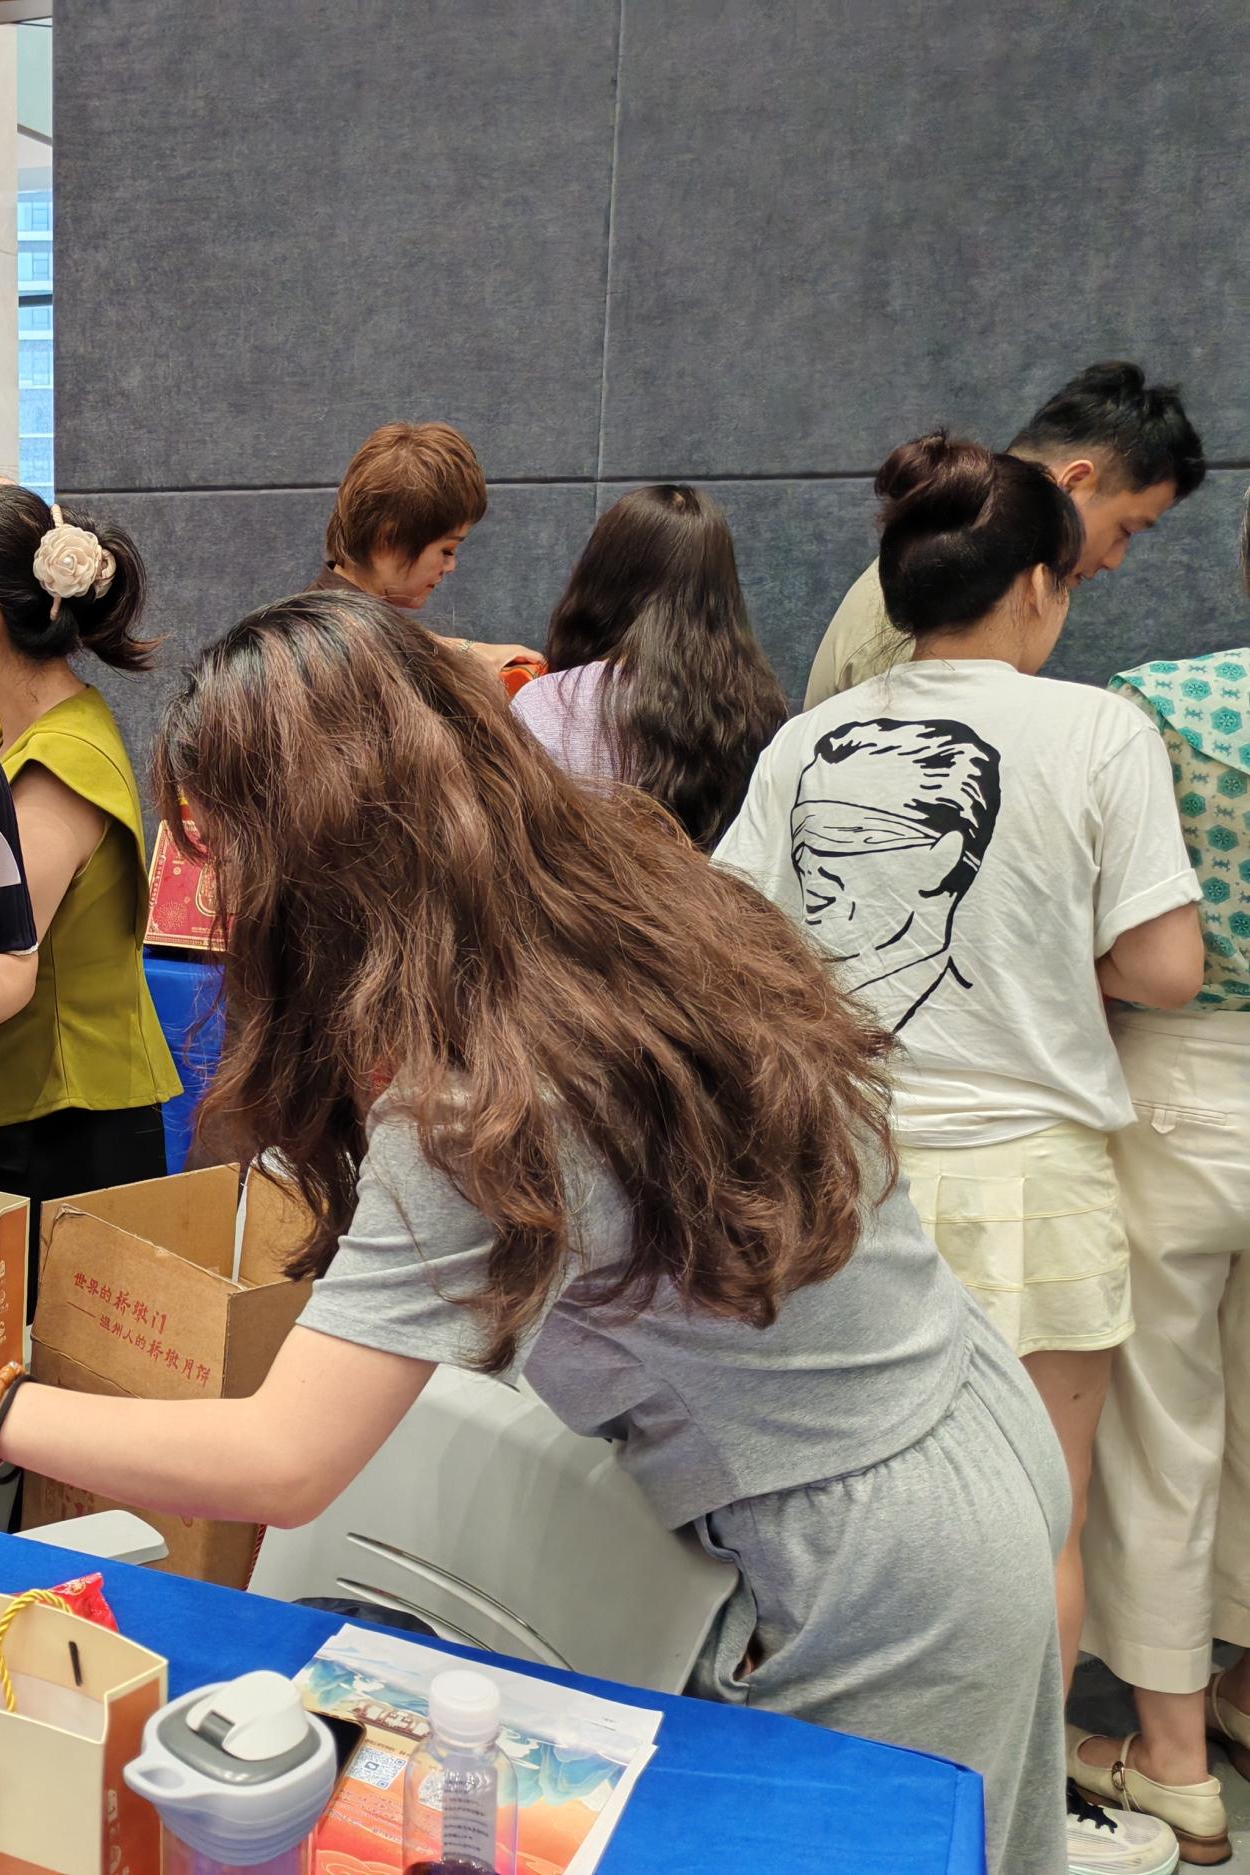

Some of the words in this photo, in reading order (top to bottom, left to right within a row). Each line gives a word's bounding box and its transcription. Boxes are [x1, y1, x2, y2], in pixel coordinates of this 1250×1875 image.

[74, 1272, 168, 1335] 世界的桥墩门
